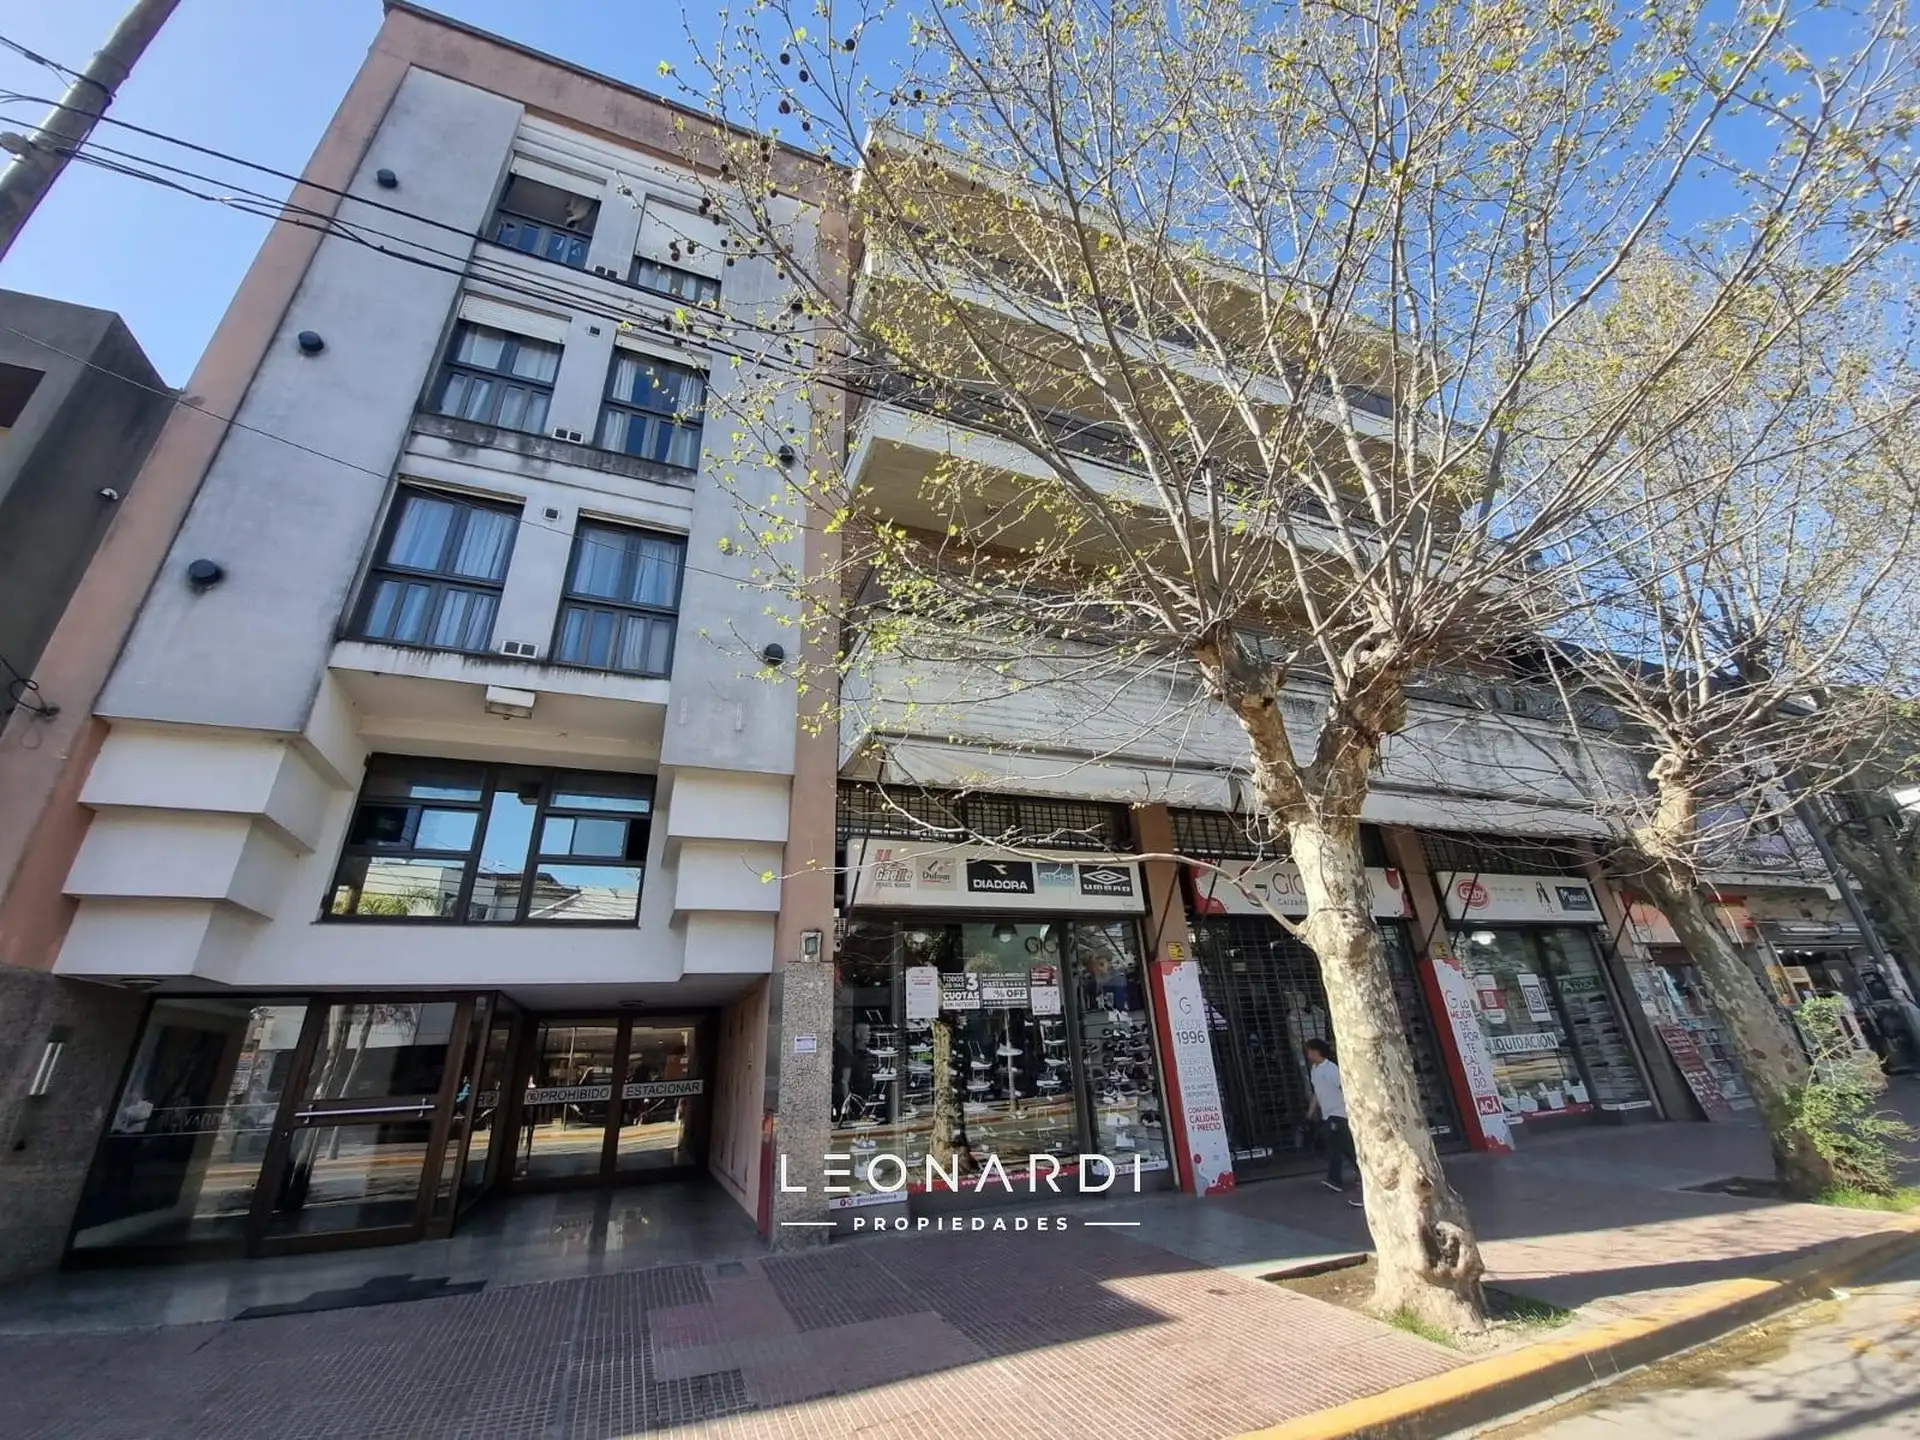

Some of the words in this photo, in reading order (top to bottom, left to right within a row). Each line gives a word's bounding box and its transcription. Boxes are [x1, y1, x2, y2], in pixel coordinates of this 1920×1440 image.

[973, 879, 1028, 890] DIADORA
[966, 973, 979, 991] 3
[943, 992, 980, 1000] CUOTAS
[1006, 989, 1026, 998] OFF
[1460, 999, 1469, 1009] LO
[1450, 1009, 1474, 1020] MEJOR
[1176, 1030, 1206, 1044] 1996
[1472, 1066, 1485, 1077] ZA
[1474, 1077, 1487, 1089] DO
[539, 1086, 610, 1102] PROHIBIDO
[626, 1082, 700, 1098] ESTACIONAR
[1189, 1113, 1220, 1124] CALIDAD
[1197, 1122, 1221, 1132] PRECIO
